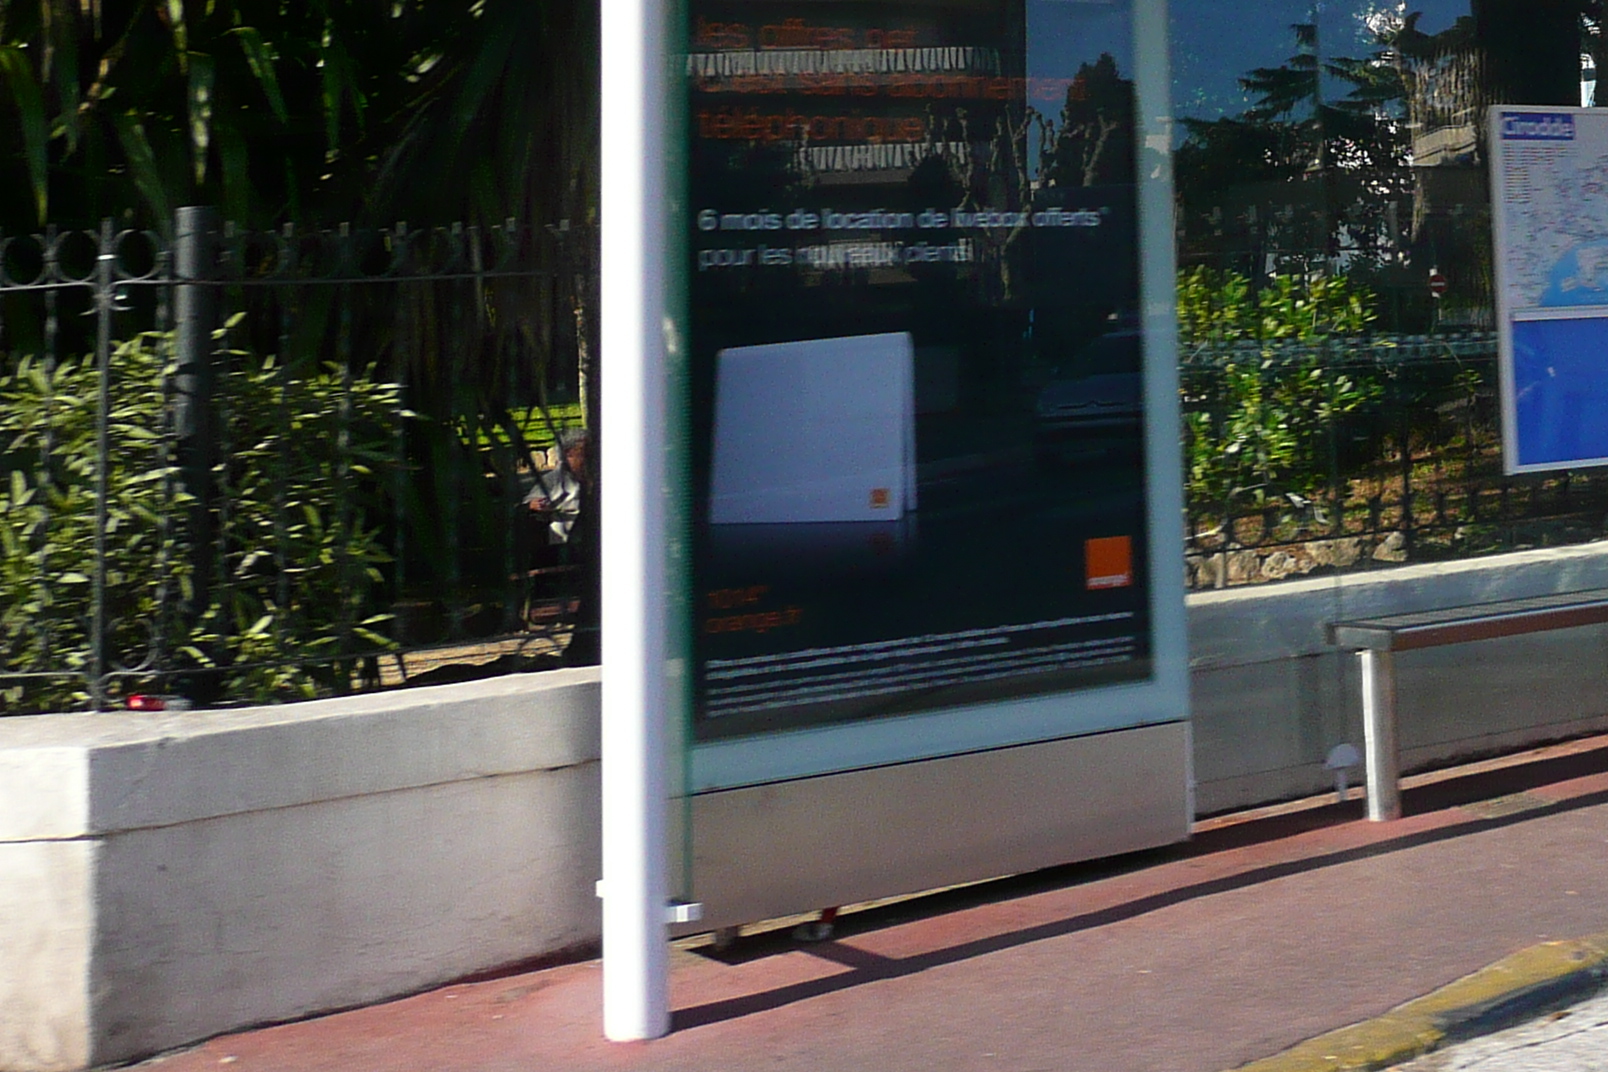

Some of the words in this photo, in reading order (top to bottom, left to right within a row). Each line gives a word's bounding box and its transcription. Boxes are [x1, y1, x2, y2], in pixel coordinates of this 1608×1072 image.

[697, 207, 718, 231] 6
[720, 208, 784, 231] mois
[785, 207, 820, 230] de
[821, 207, 914, 230] location
[916, 207, 949, 228] de
[698, 247, 757, 271] pour
[758, 244, 794, 266] les
